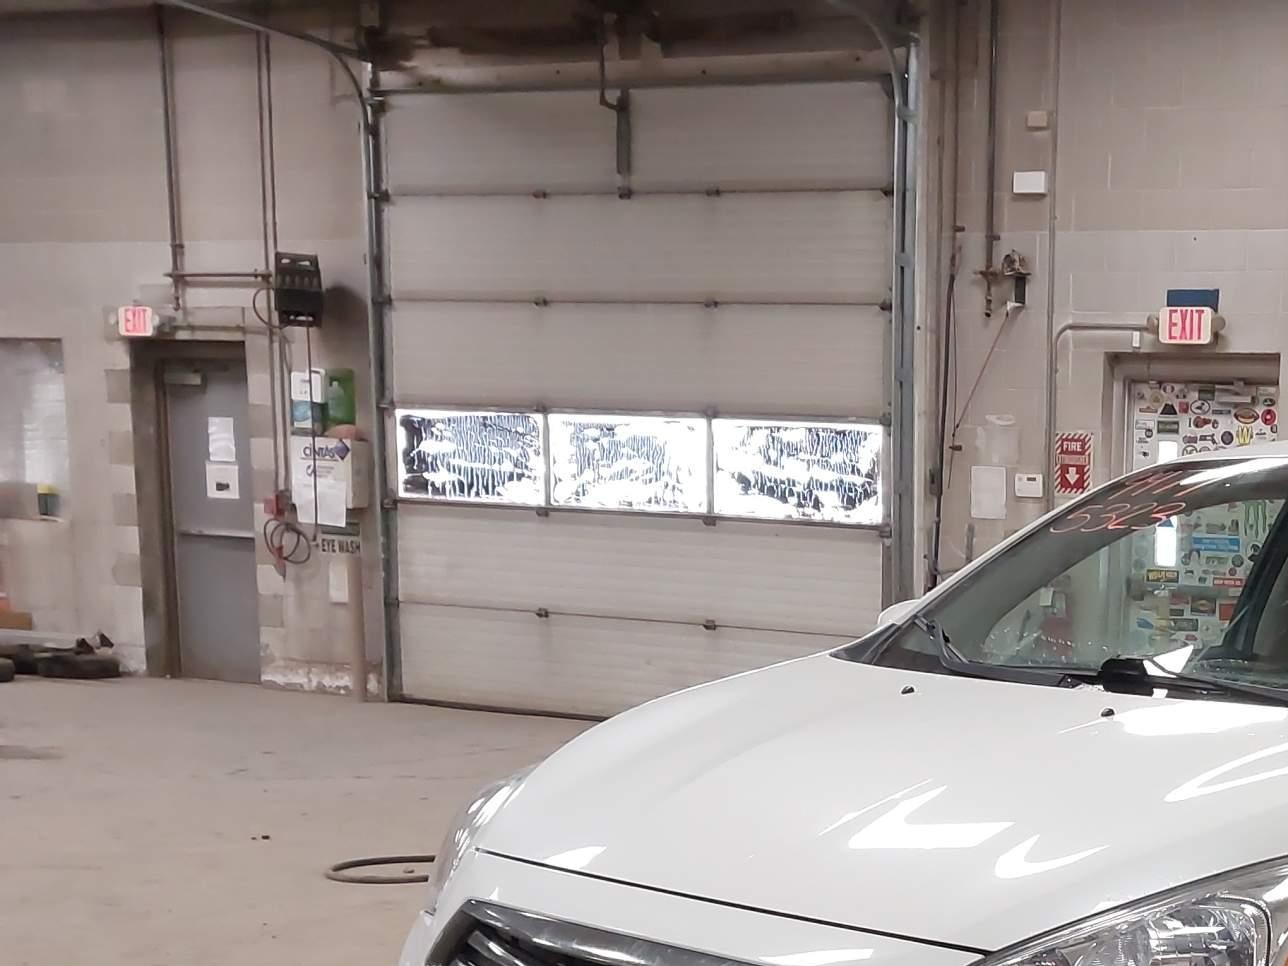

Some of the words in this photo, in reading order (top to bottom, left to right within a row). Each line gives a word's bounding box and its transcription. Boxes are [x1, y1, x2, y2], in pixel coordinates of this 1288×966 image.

[125, 308, 147, 333] EXIT
[1168, 309, 1204, 340] EXIT
[1062, 441, 1082, 452] FIRE
[321, 538, 337, 553] EYE
[338, 538, 361, 553] WASH
